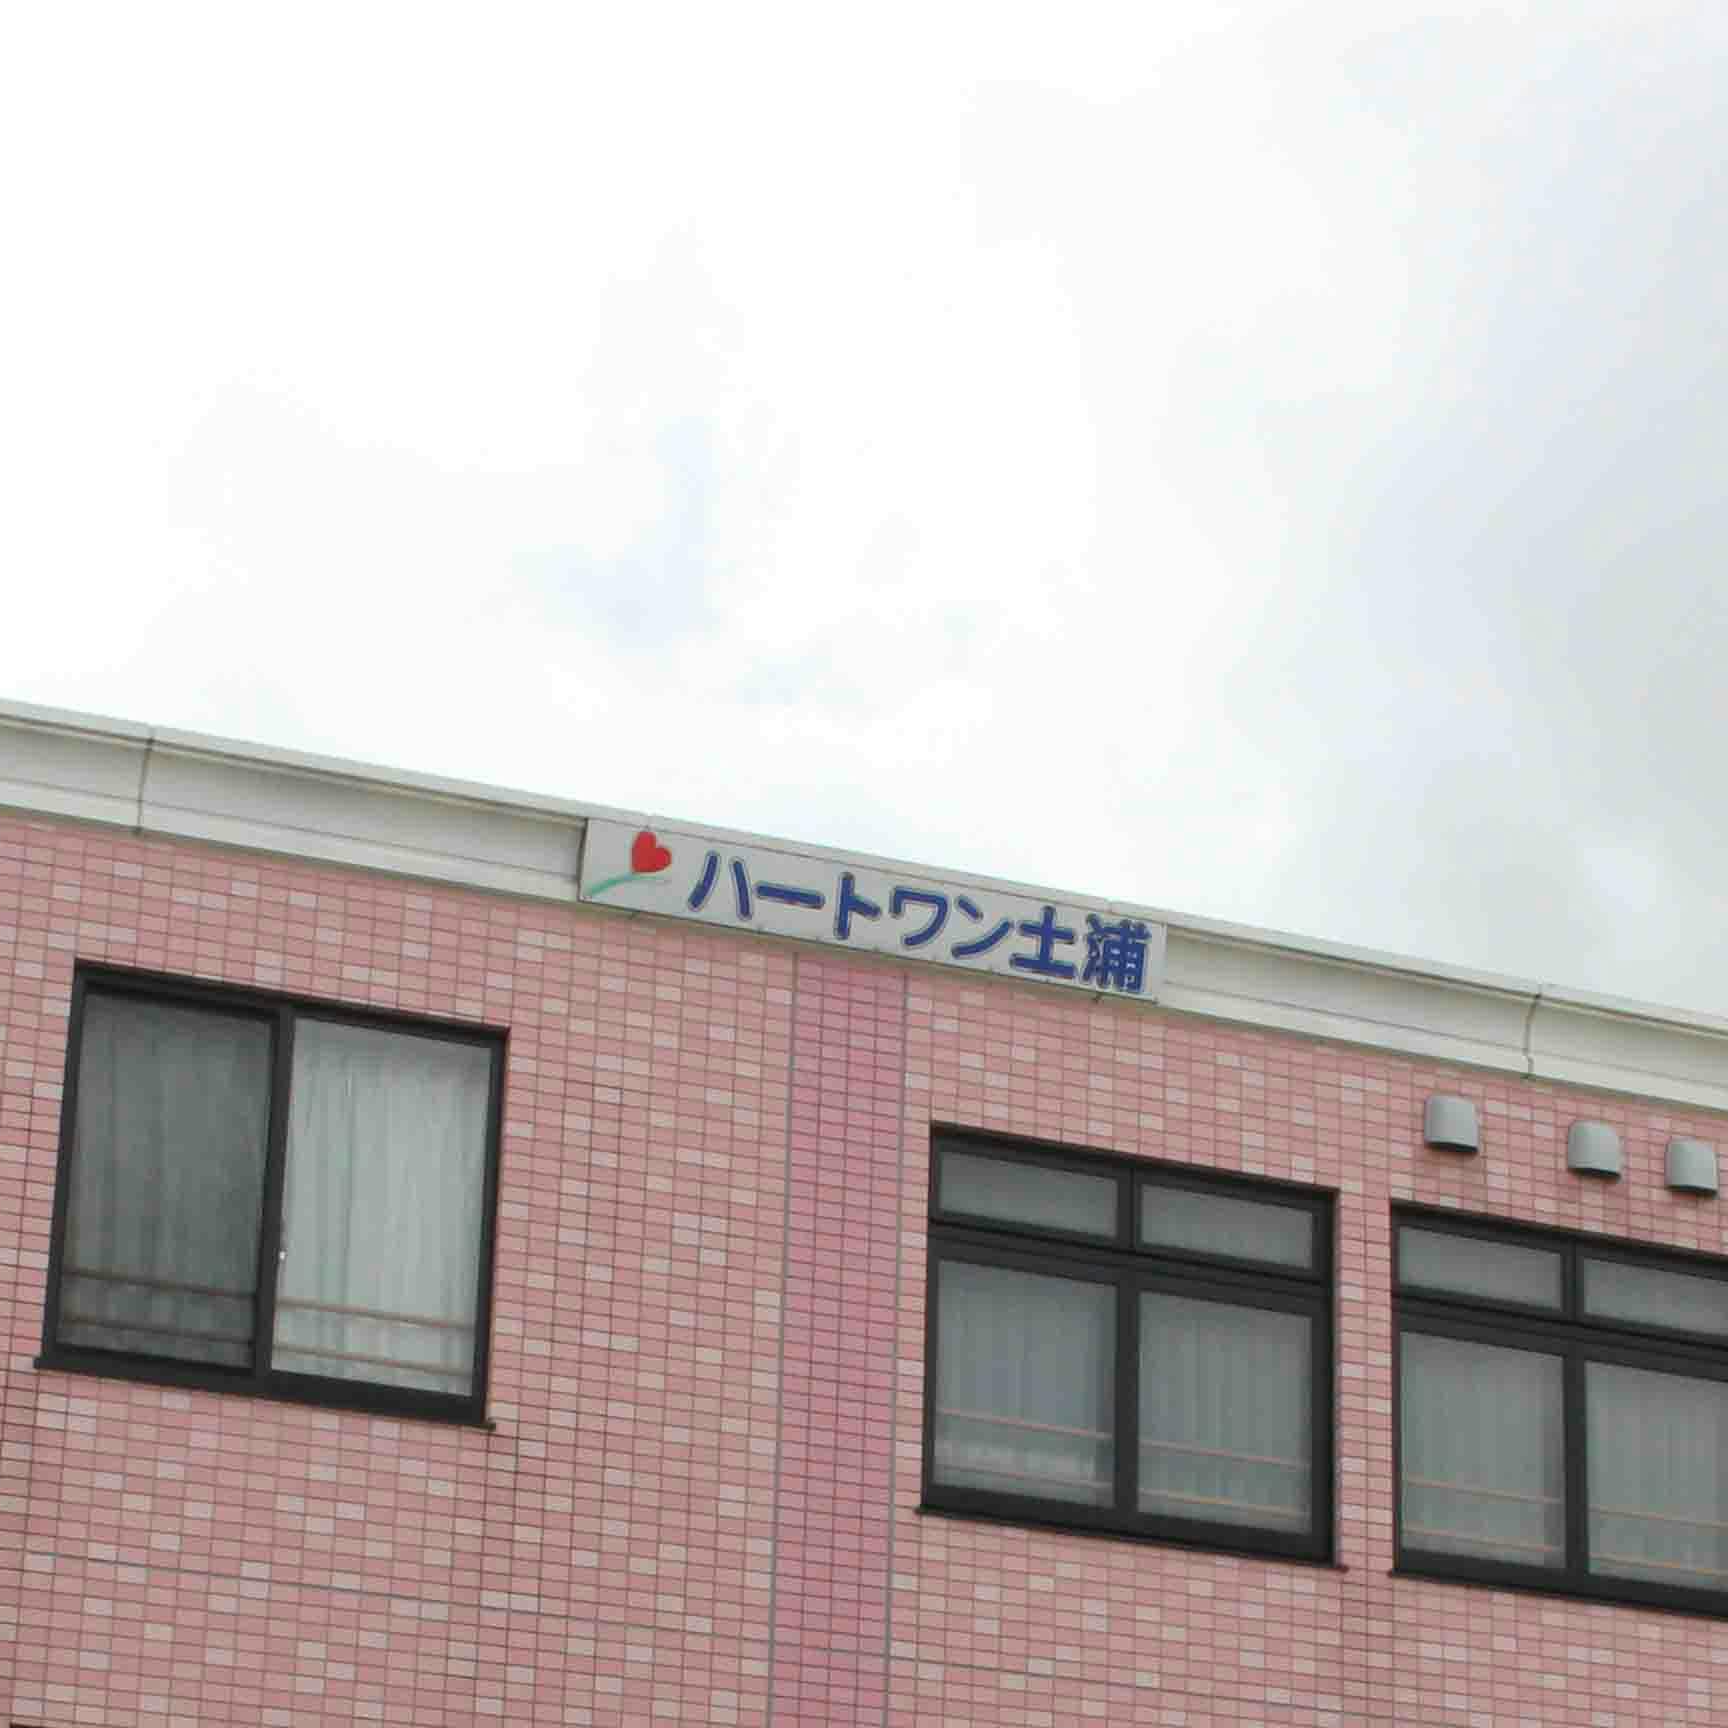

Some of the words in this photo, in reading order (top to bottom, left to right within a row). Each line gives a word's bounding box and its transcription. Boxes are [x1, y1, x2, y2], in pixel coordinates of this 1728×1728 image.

[686, 850, 1150, 994] ハートワン土浦
